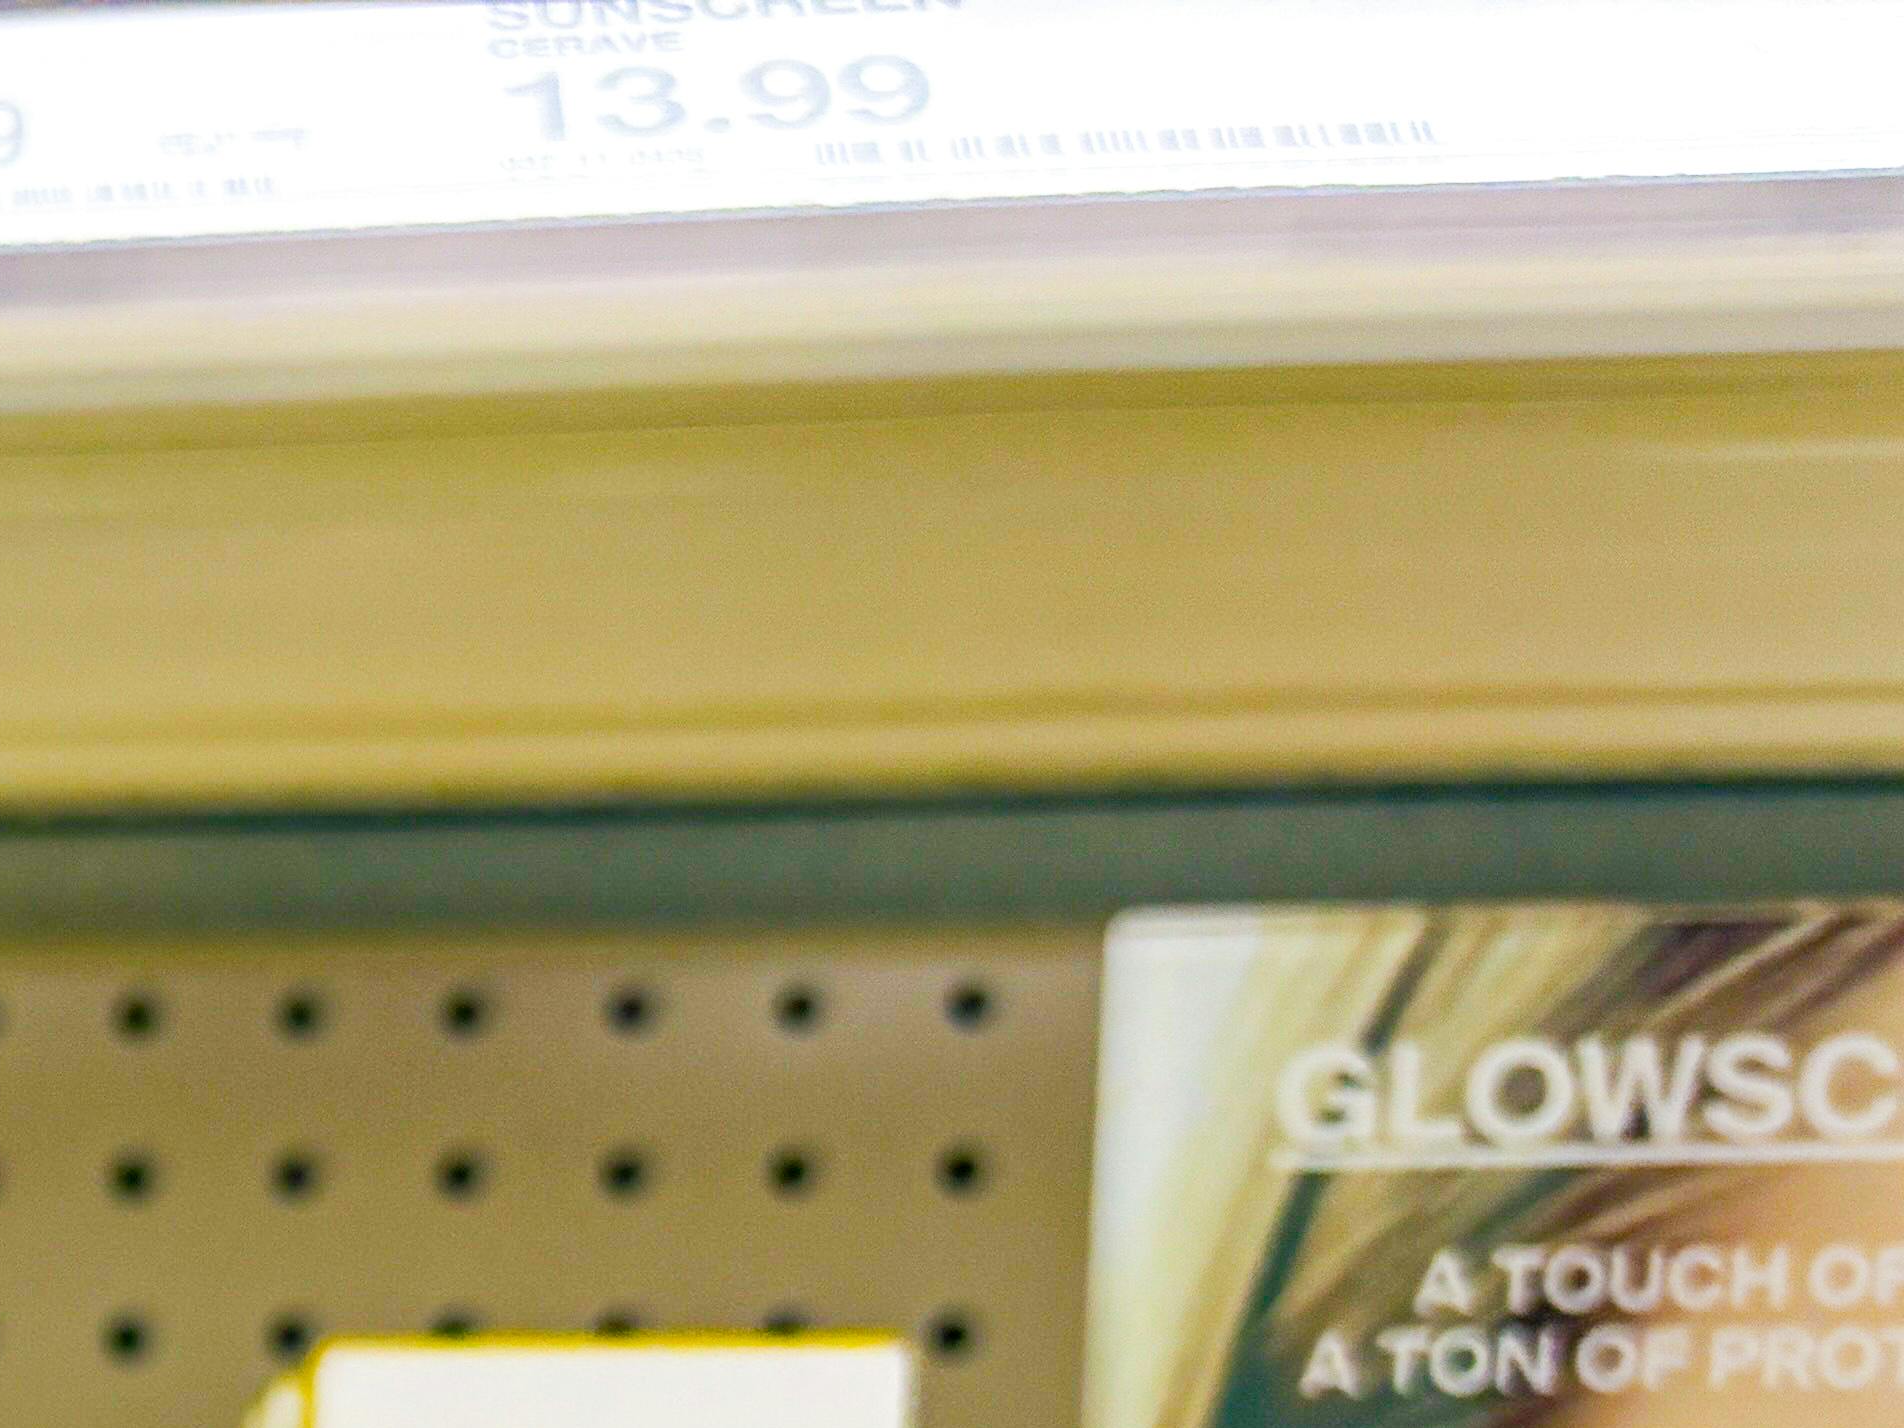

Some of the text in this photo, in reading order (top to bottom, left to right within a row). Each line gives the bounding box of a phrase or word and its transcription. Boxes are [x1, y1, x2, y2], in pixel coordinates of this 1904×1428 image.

[484, 0, 967, 32] SUNSCR
[486, 28, 686, 60] CERAVE
[502, 52, 932, 142] 13.99
[1414, 1248, 1474, 1318] A
[1495, 1244, 1789, 1316] TOUCH
[1298, 1329, 1360, 1400] A
[1378, 1324, 1559, 1398] TON
[1575, 1322, 1692, 1396] OF
